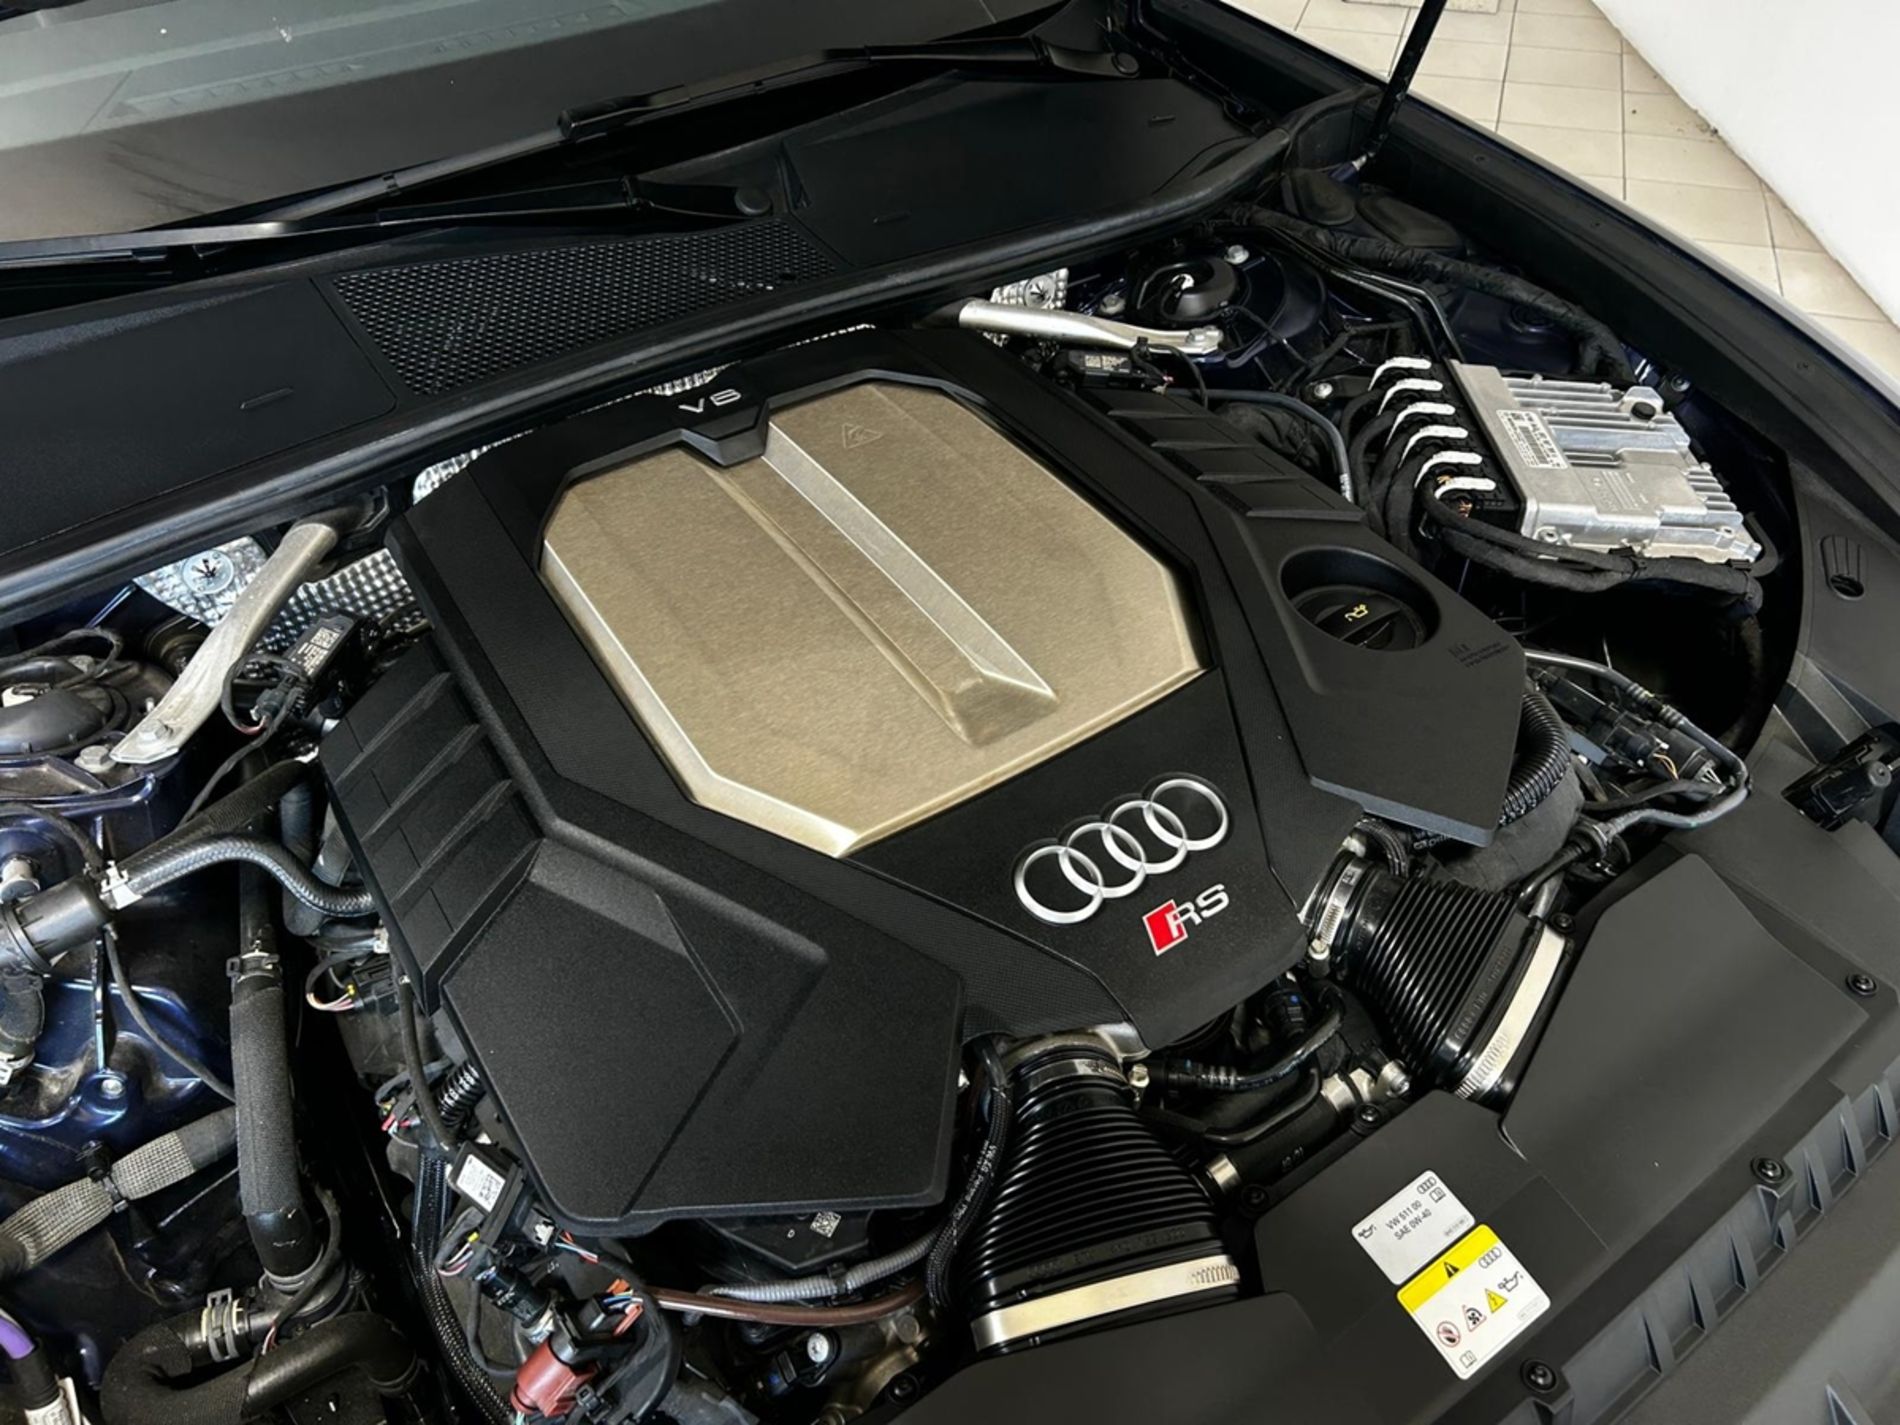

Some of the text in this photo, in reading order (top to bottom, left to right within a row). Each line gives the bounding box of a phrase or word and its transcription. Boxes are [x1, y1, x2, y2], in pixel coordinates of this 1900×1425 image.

[678, 388, 742, 413] V8
[1165, 883, 1231, 940] RS
[1385, 1199, 1422, 1230] VW 511 00
[1394, 1225, 1411, 1240] SAE
[1409, 1208, 1432, 1228] 0W-40
